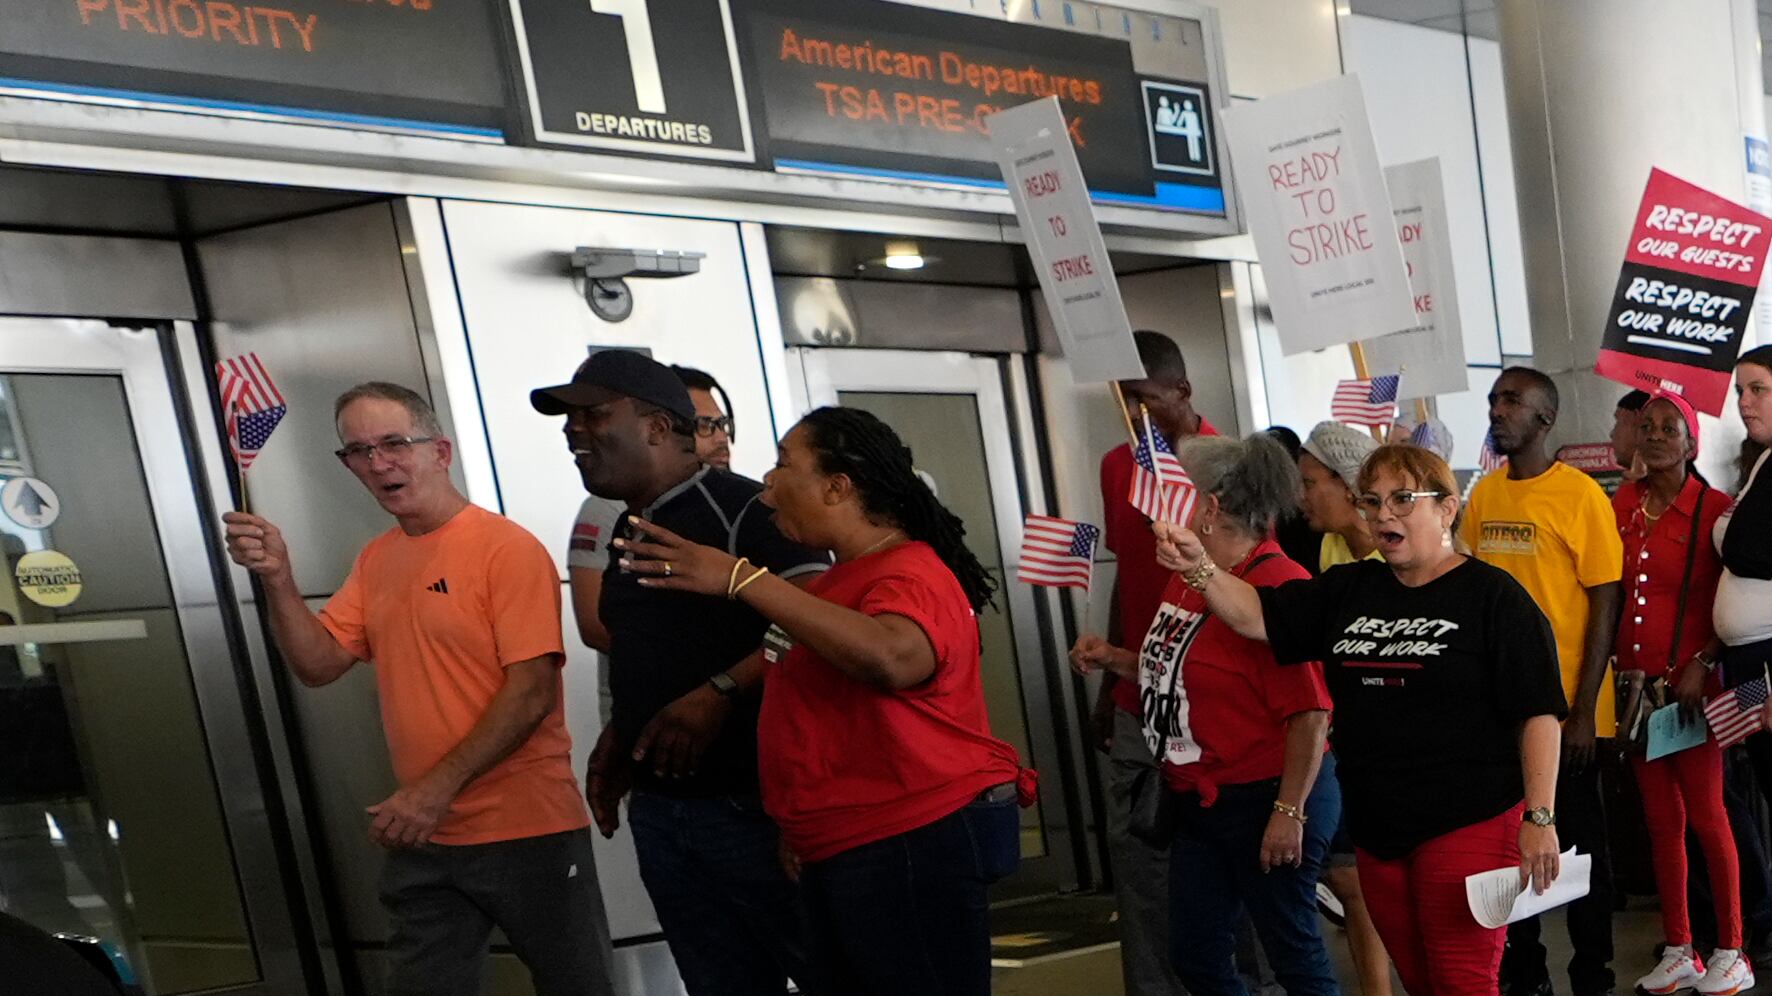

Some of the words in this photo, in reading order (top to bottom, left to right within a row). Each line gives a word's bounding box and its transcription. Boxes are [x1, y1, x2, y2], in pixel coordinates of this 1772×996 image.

[75, 0, 317, 52] PRIORITY
[590, 0, 667, 114] 1
[780, 28, 934, 80] American
[939, 51, 1102, 105] Departures
[575, 111, 713, 145] DEPARTURES
[815, 82, 890, 124] TSA
[893, 92, 1087, 148] PRE-CK
[1024, 169, 1062, 197] READY
[1268, 145, 1341, 191] READY
[1292, 188, 1335, 218] TO
[1048, 214, 1067, 240] TO
[1288, 214, 1374, 266] STRIKE
[1645, 204, 1762, 248] RESPECT
[1052, 255, 1094, 282] STRIKE
[1637, 237, 1679, 258] OUR
[1680, 245, 1754, 272] GUESTS
[1625, 277, 1741, 321] RESPECT
[1617, 310, 1664, 333] OUR
[1666, 317, 1734, 343] WORK
[19, 574, 81, 586] CAUTION
[1344, 616, 1459, 638] RESPECT
[1332, 639, 1377, 655] OUR
[1379, 640, 1448, 656] WORK
